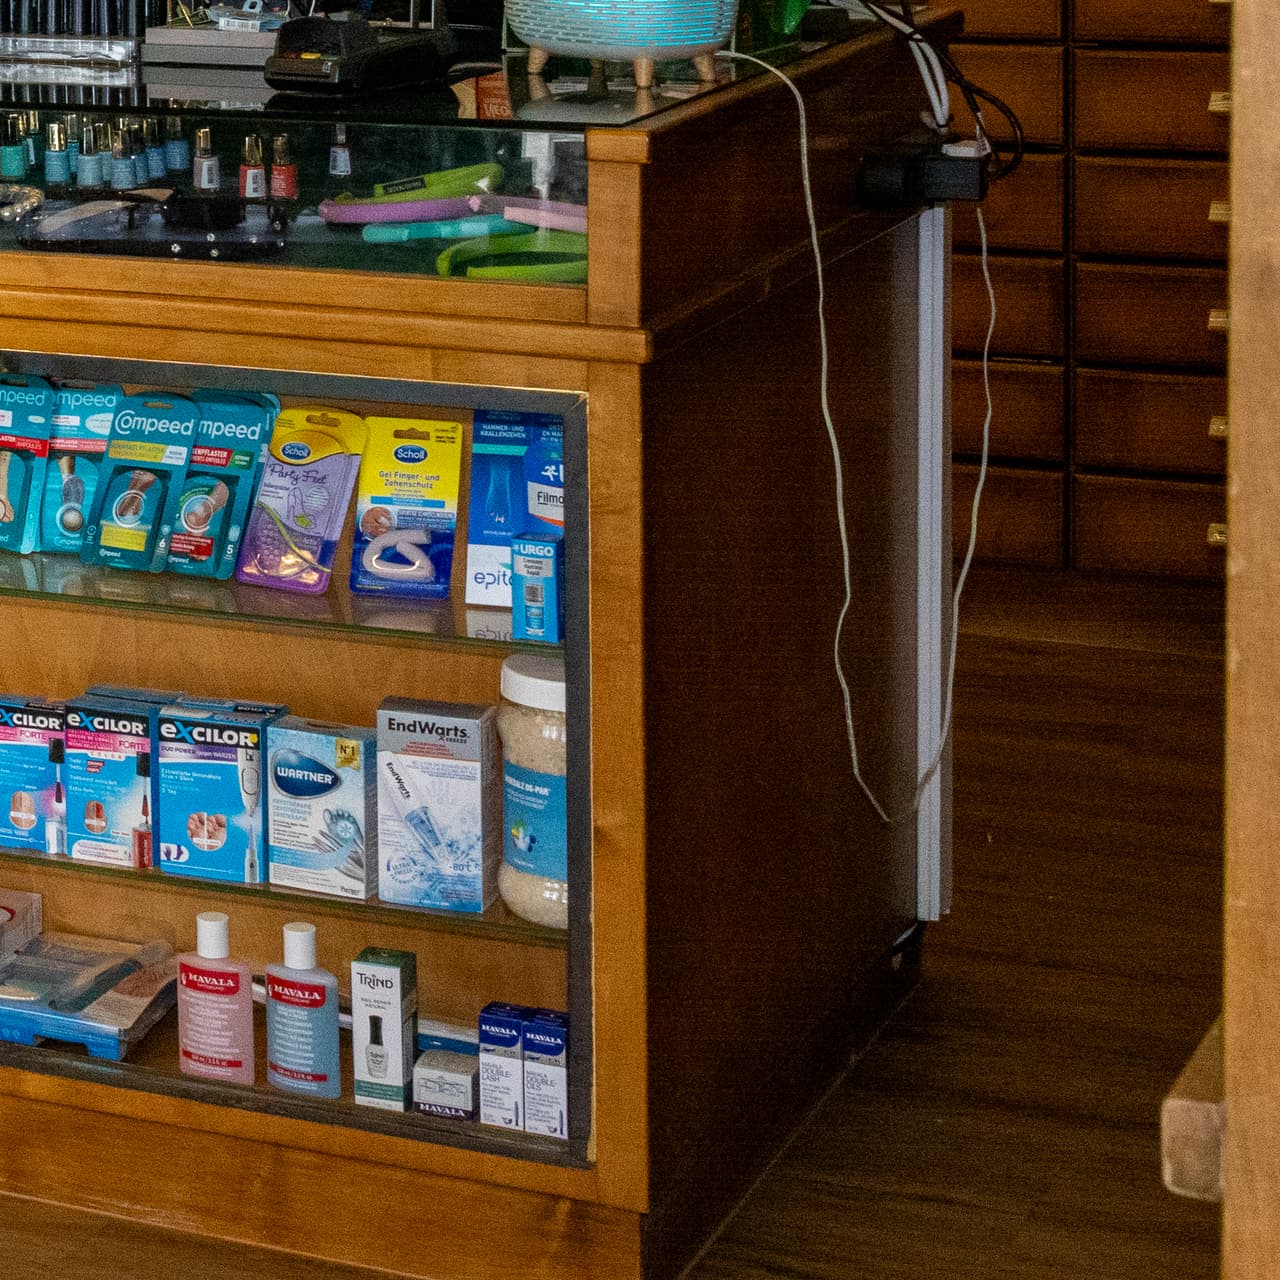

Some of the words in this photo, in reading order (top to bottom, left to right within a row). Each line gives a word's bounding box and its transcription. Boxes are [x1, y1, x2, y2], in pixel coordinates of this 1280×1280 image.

[114, 409, 194, 437] Compeed
[283, 444, 311, 459] Scholl
[395, 446, 425, 461] Scholl
[379, 472, 393, 481] Gel
[425, 474, 440, 482] und
[520, 544, 554, 557] URGO
[388, 717, 467, 738] EndWarts
[20, 730, 47, 741] FORTE
[277, 767, 332, 784] WARTNER
[386, 762, 411, 800] EndWarts
[188, 973, 235, 988] MAVALA
[274, 984, 321, 1001] MAVALA
[481, 1024, 518, 1036] MAVALA
[419, 1102, 466, 1118] MAVALA
